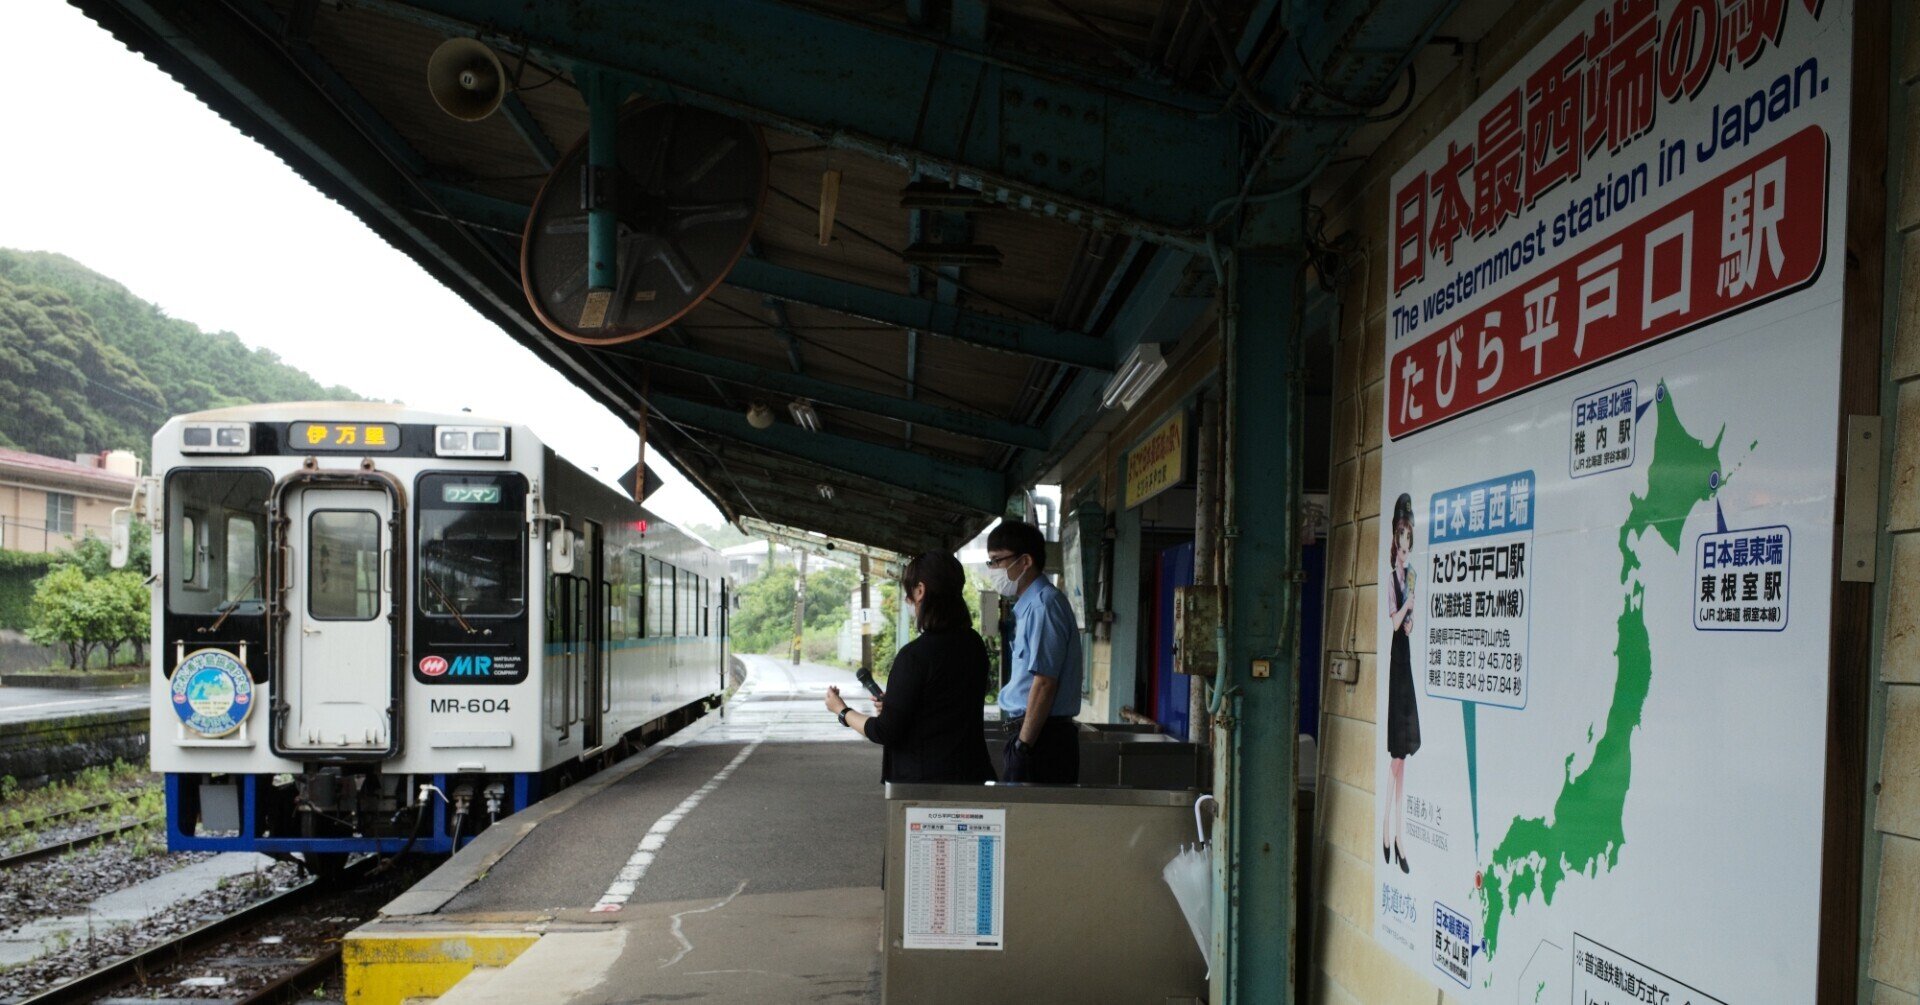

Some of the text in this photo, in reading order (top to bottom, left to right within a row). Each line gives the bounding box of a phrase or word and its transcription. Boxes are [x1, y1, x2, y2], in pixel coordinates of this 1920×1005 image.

[1392, 56, 1829, 340] The westernmost station in Japan.
[1400, 155, 1787, 425] たびら平戸口駅
[1576, 388, 1632, 427] 日本最北端
[306, 424, 386, 445] 伊万里
[447, 489, 497, 503] ワンマン
[1434, 478, 1529, 538] 日本最西端
[1432, 543, 1525, 583] たびら平戸口駅
[1703, 534, 1783, 569] 日本最東端
[448, 655, 492, 675] MR
[430, 699, 510, 713] MR-604
[1436, 908, 1469, 945] 日本最南端
